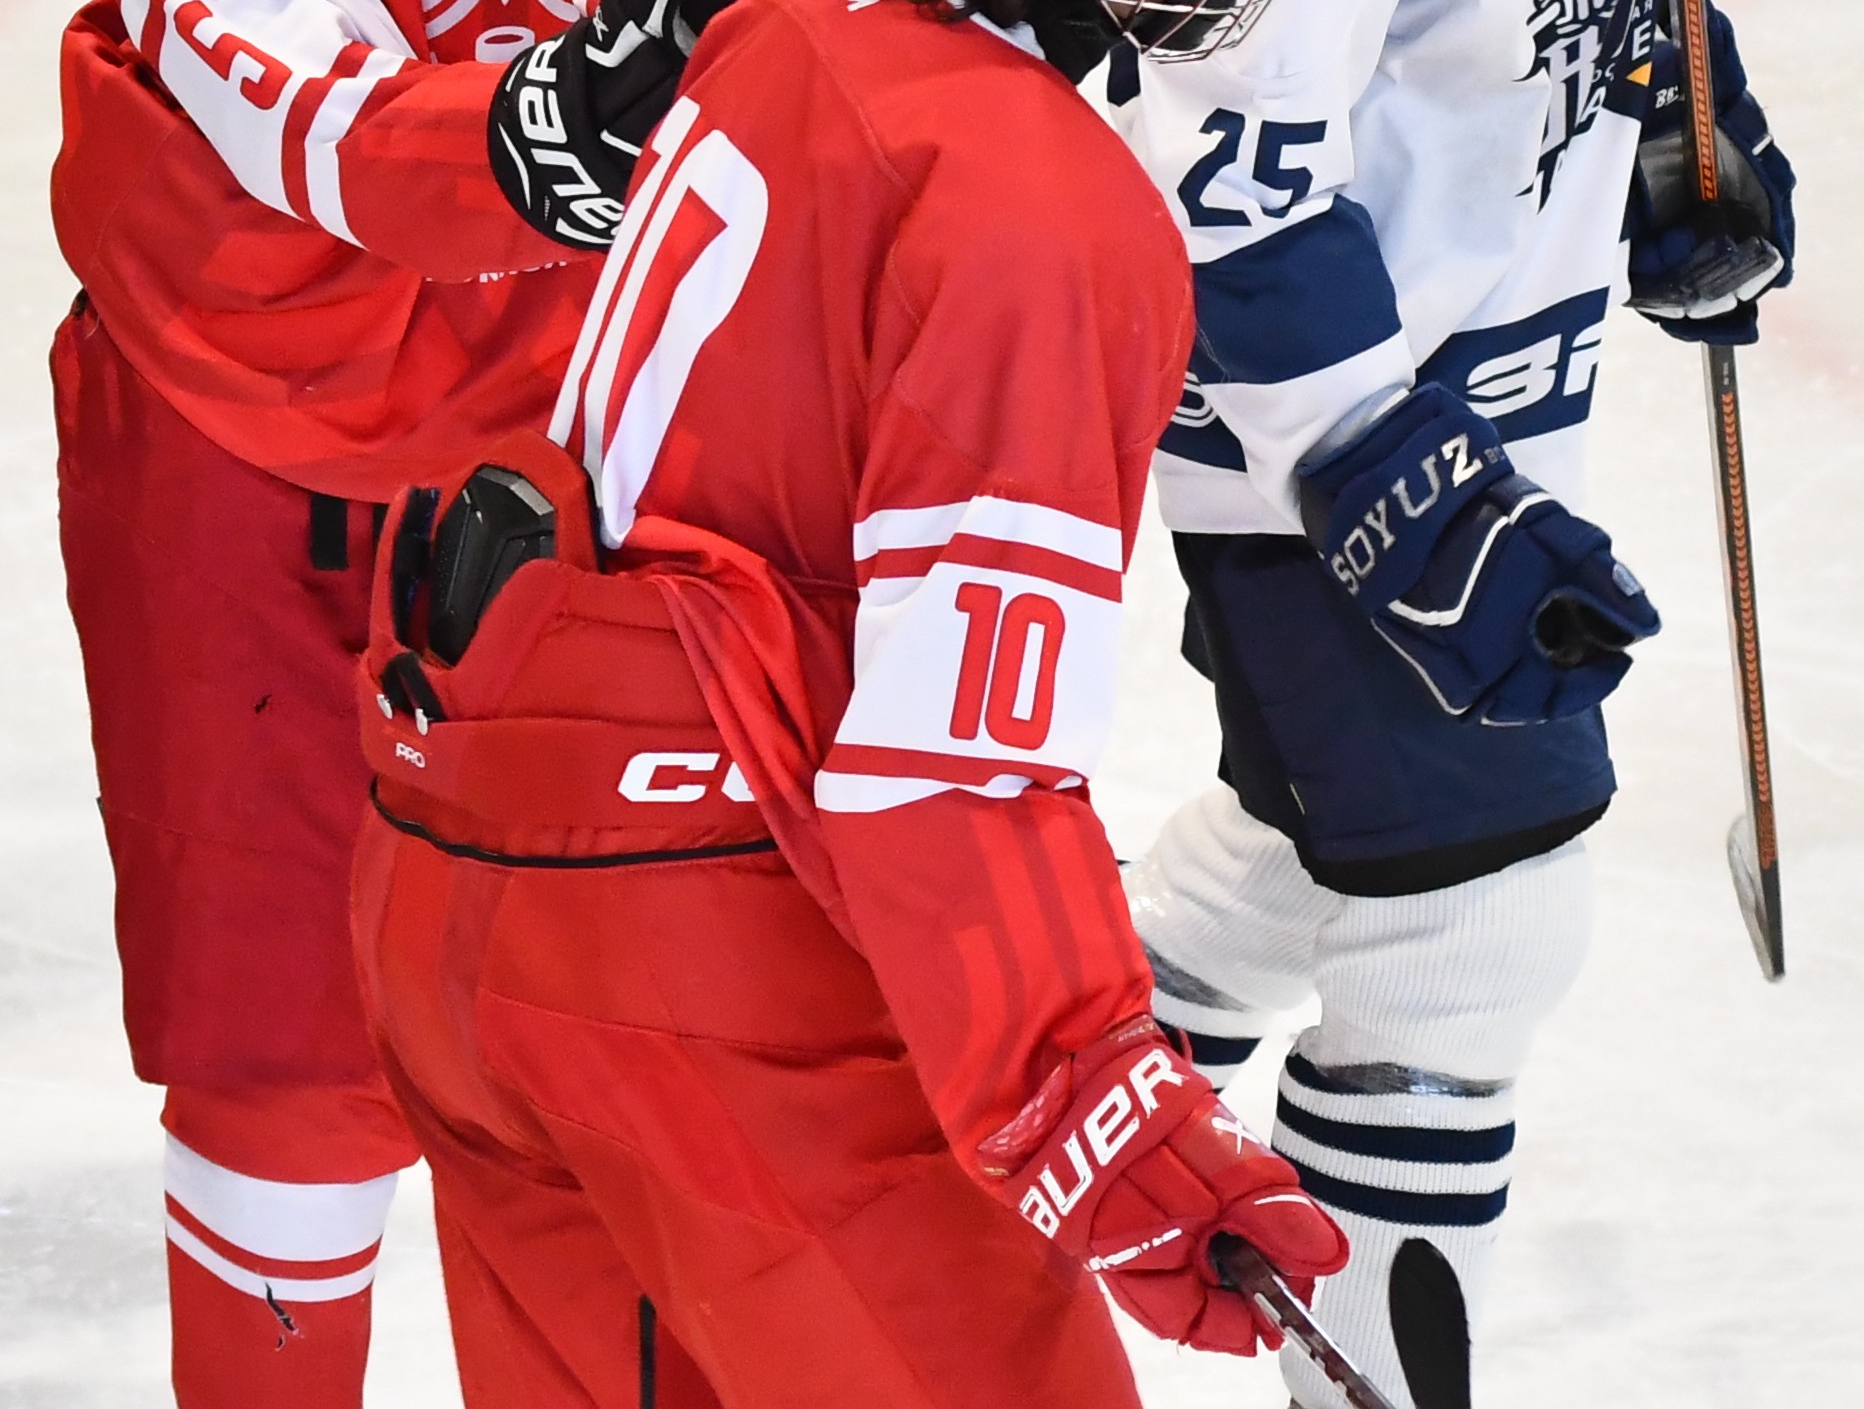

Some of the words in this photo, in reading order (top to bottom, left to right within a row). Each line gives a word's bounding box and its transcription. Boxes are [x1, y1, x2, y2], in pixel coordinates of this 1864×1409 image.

[172, 0, 293, 111] 5
[519, 34, 626, 238] AUER
[1177, 107, 1328, 227] 25
[1331, 433, 1484, 597] SOYUZ
[948, 580, 1066, 751] 10
[395, 742, 426, 768] PRO
